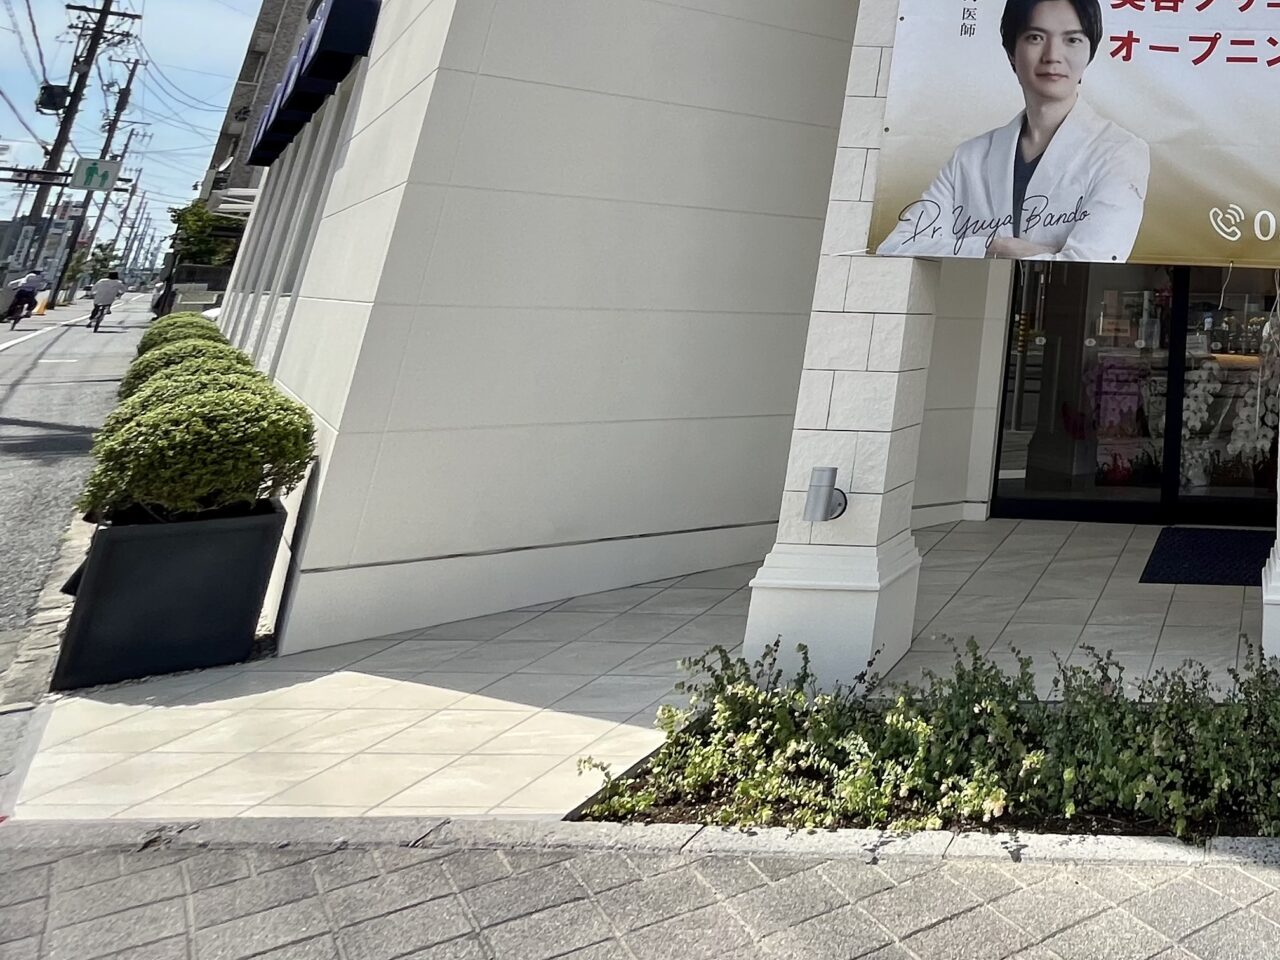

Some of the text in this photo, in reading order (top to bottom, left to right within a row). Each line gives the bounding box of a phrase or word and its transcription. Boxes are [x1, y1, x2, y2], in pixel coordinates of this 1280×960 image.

[898, 195, 1091, 256] Dr. Yuya Bando
